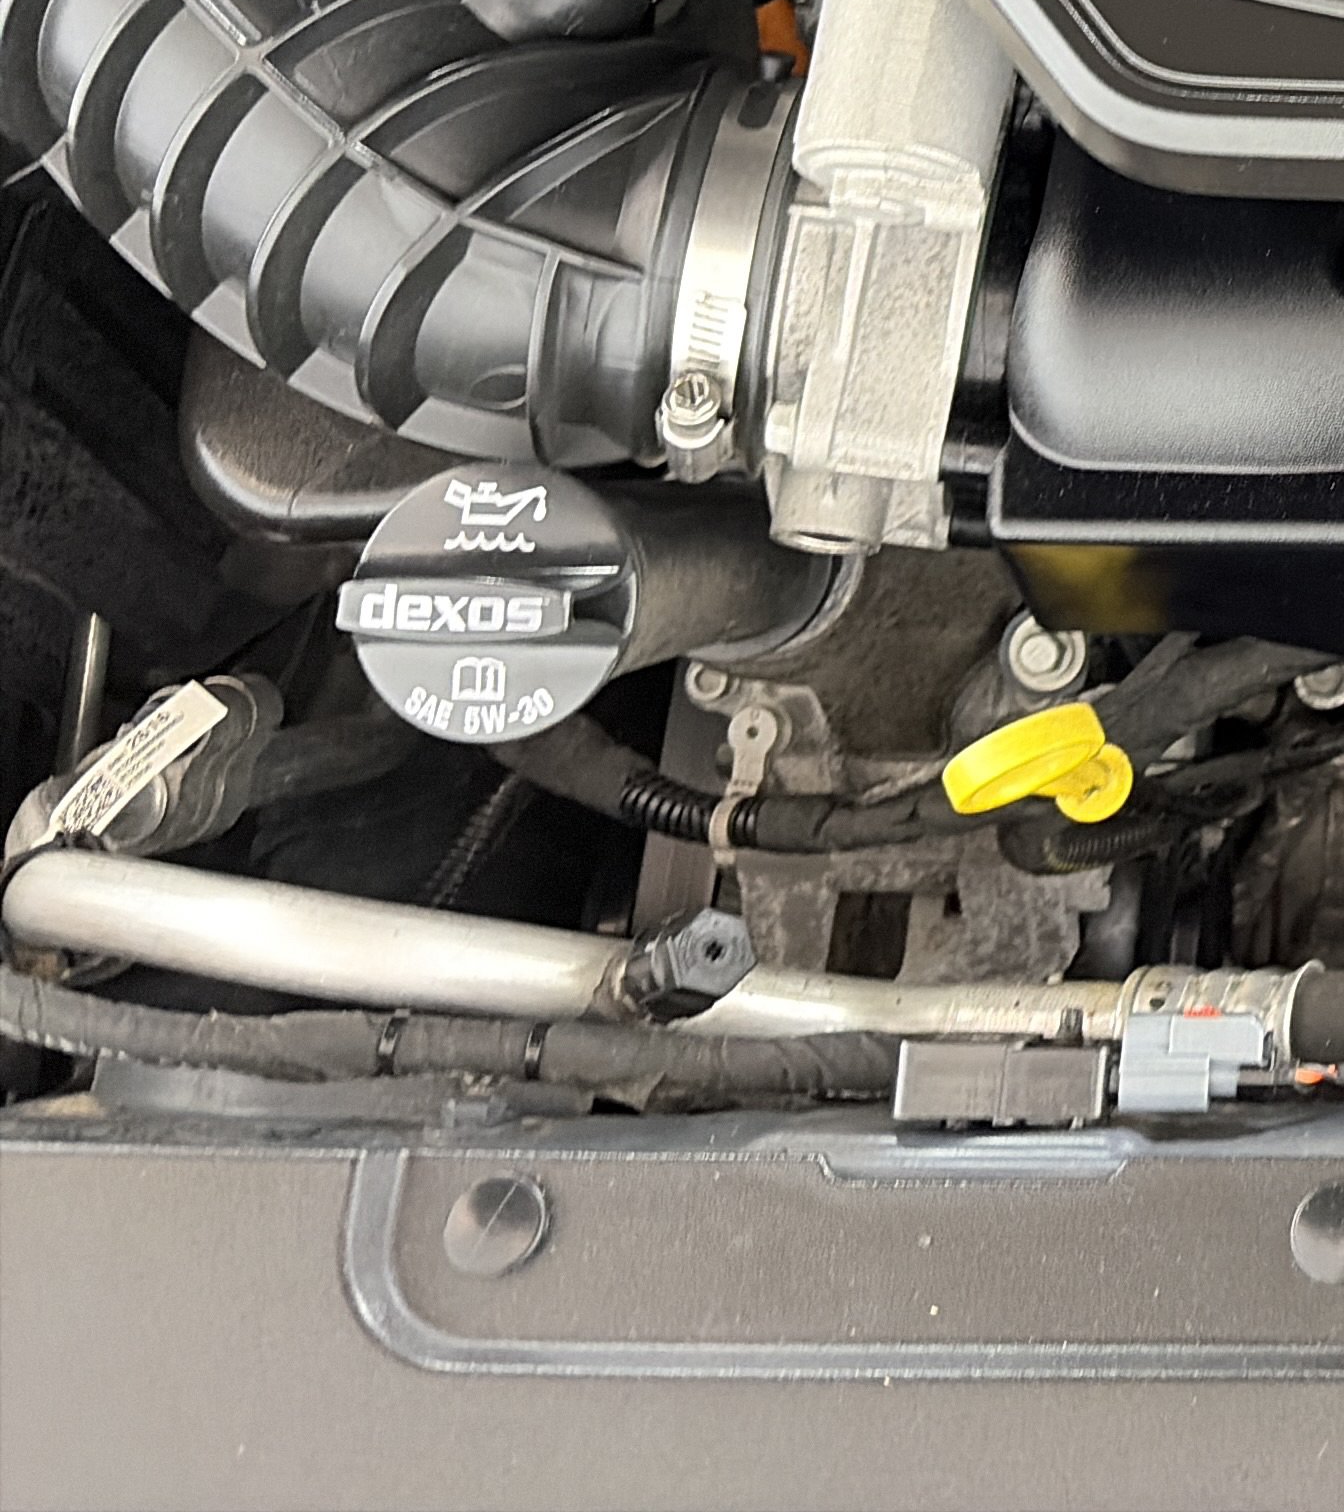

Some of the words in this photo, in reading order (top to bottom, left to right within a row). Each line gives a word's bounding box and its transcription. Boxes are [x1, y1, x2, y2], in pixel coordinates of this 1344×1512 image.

[359, 583, 544, 633] dexos
[404, 685, 454, 731] SAE
[463, 687, 555, 736] 5W-30
